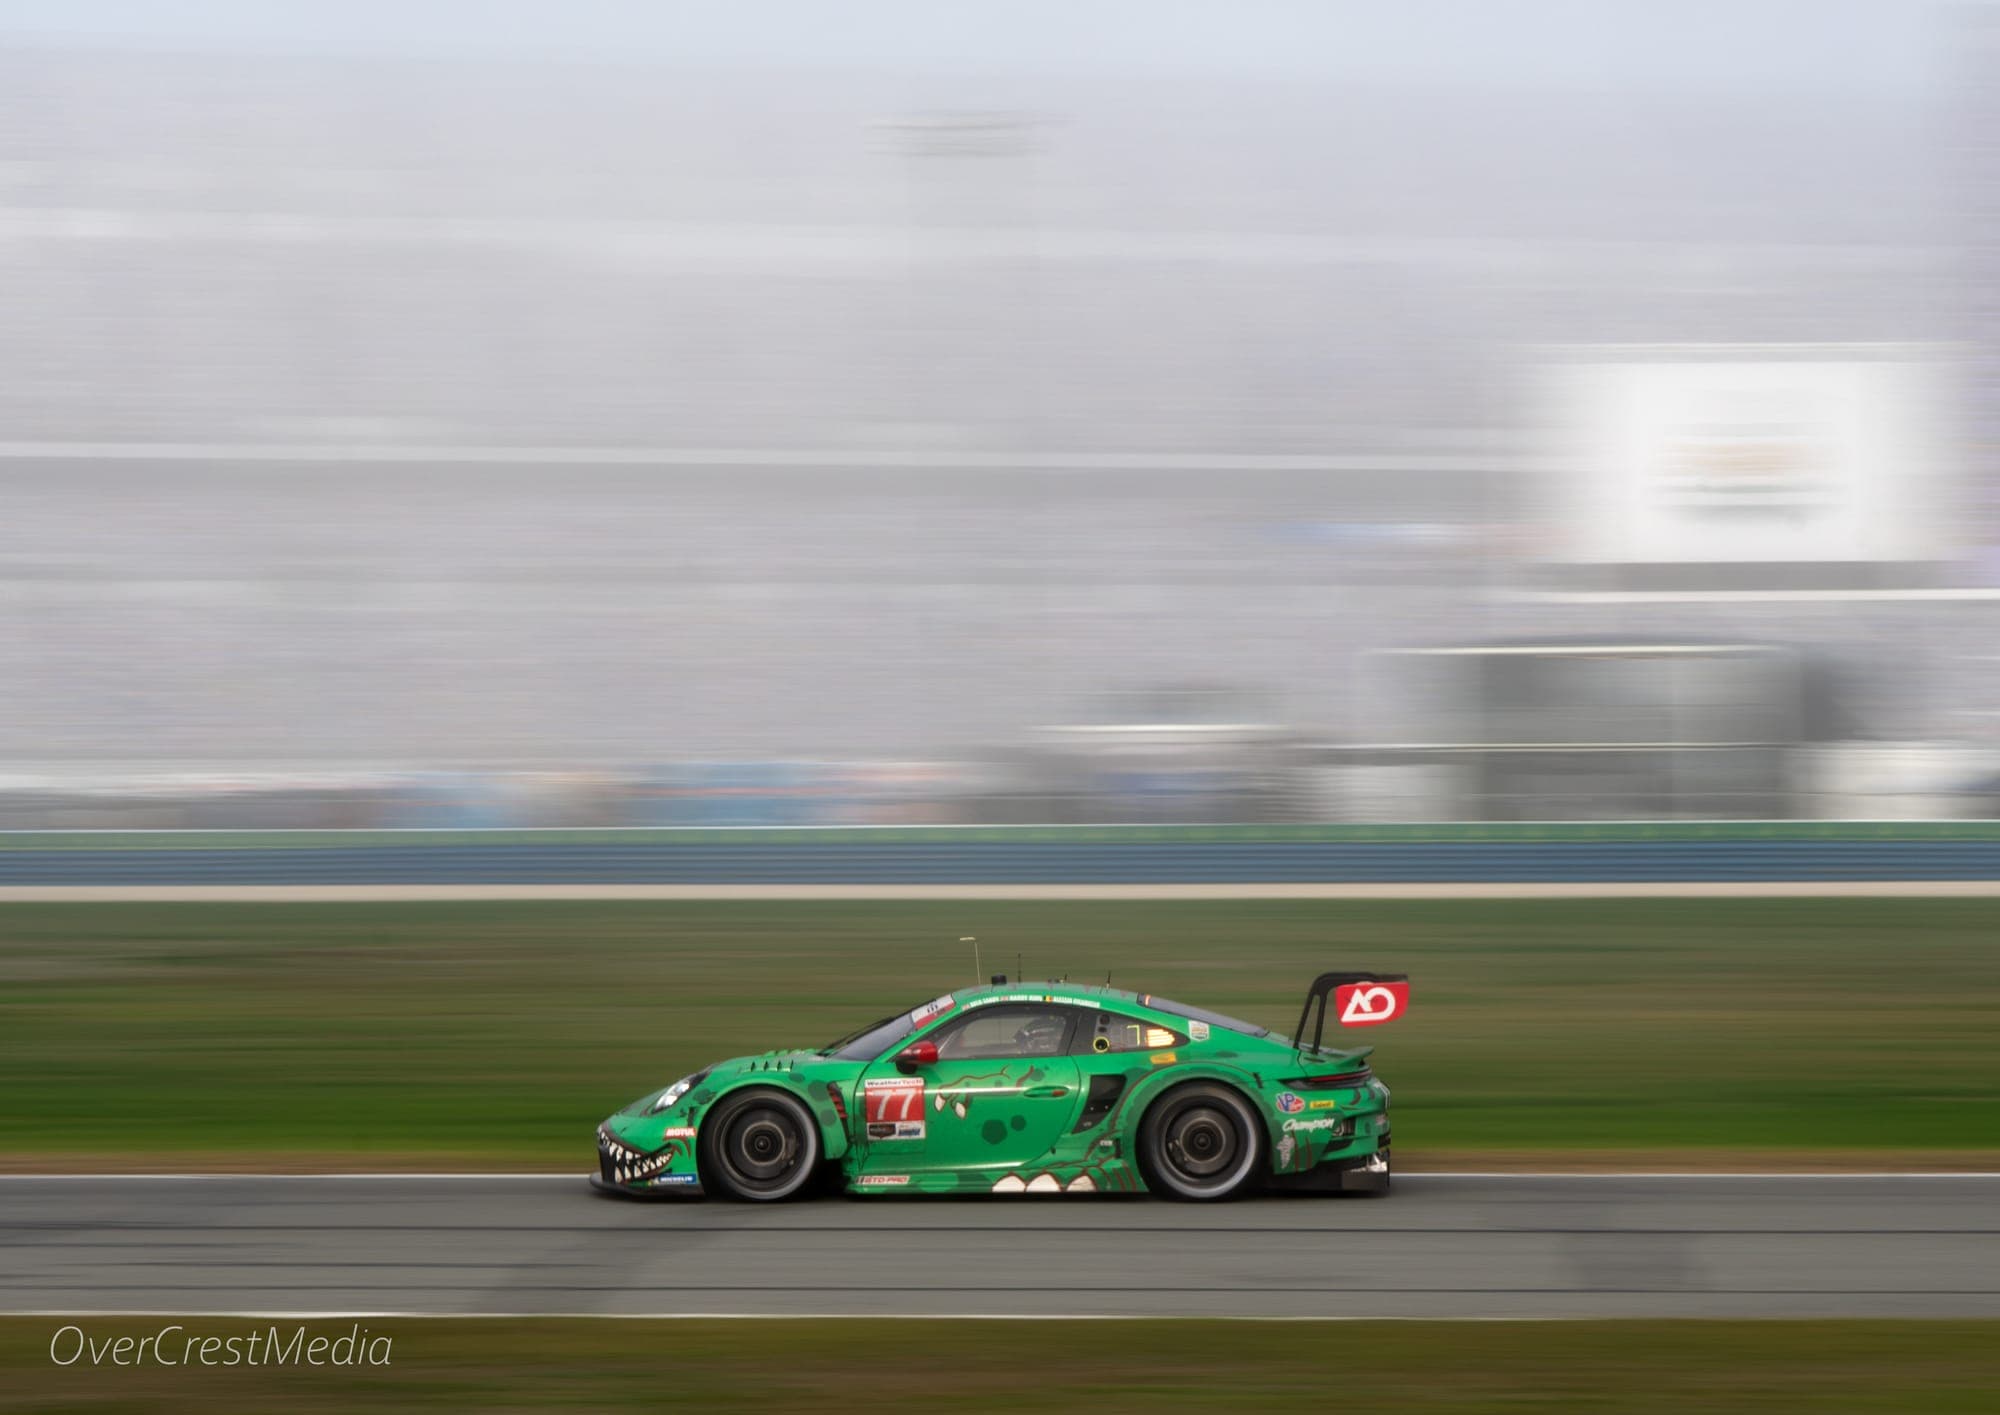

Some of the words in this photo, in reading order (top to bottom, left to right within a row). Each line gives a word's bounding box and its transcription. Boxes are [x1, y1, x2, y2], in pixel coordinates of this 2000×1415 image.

[873, 1088, 916, 1121] 77
[1277, 1092, 1296, 1112] VP
[666, 1127, 694, 1137] MOTUL
